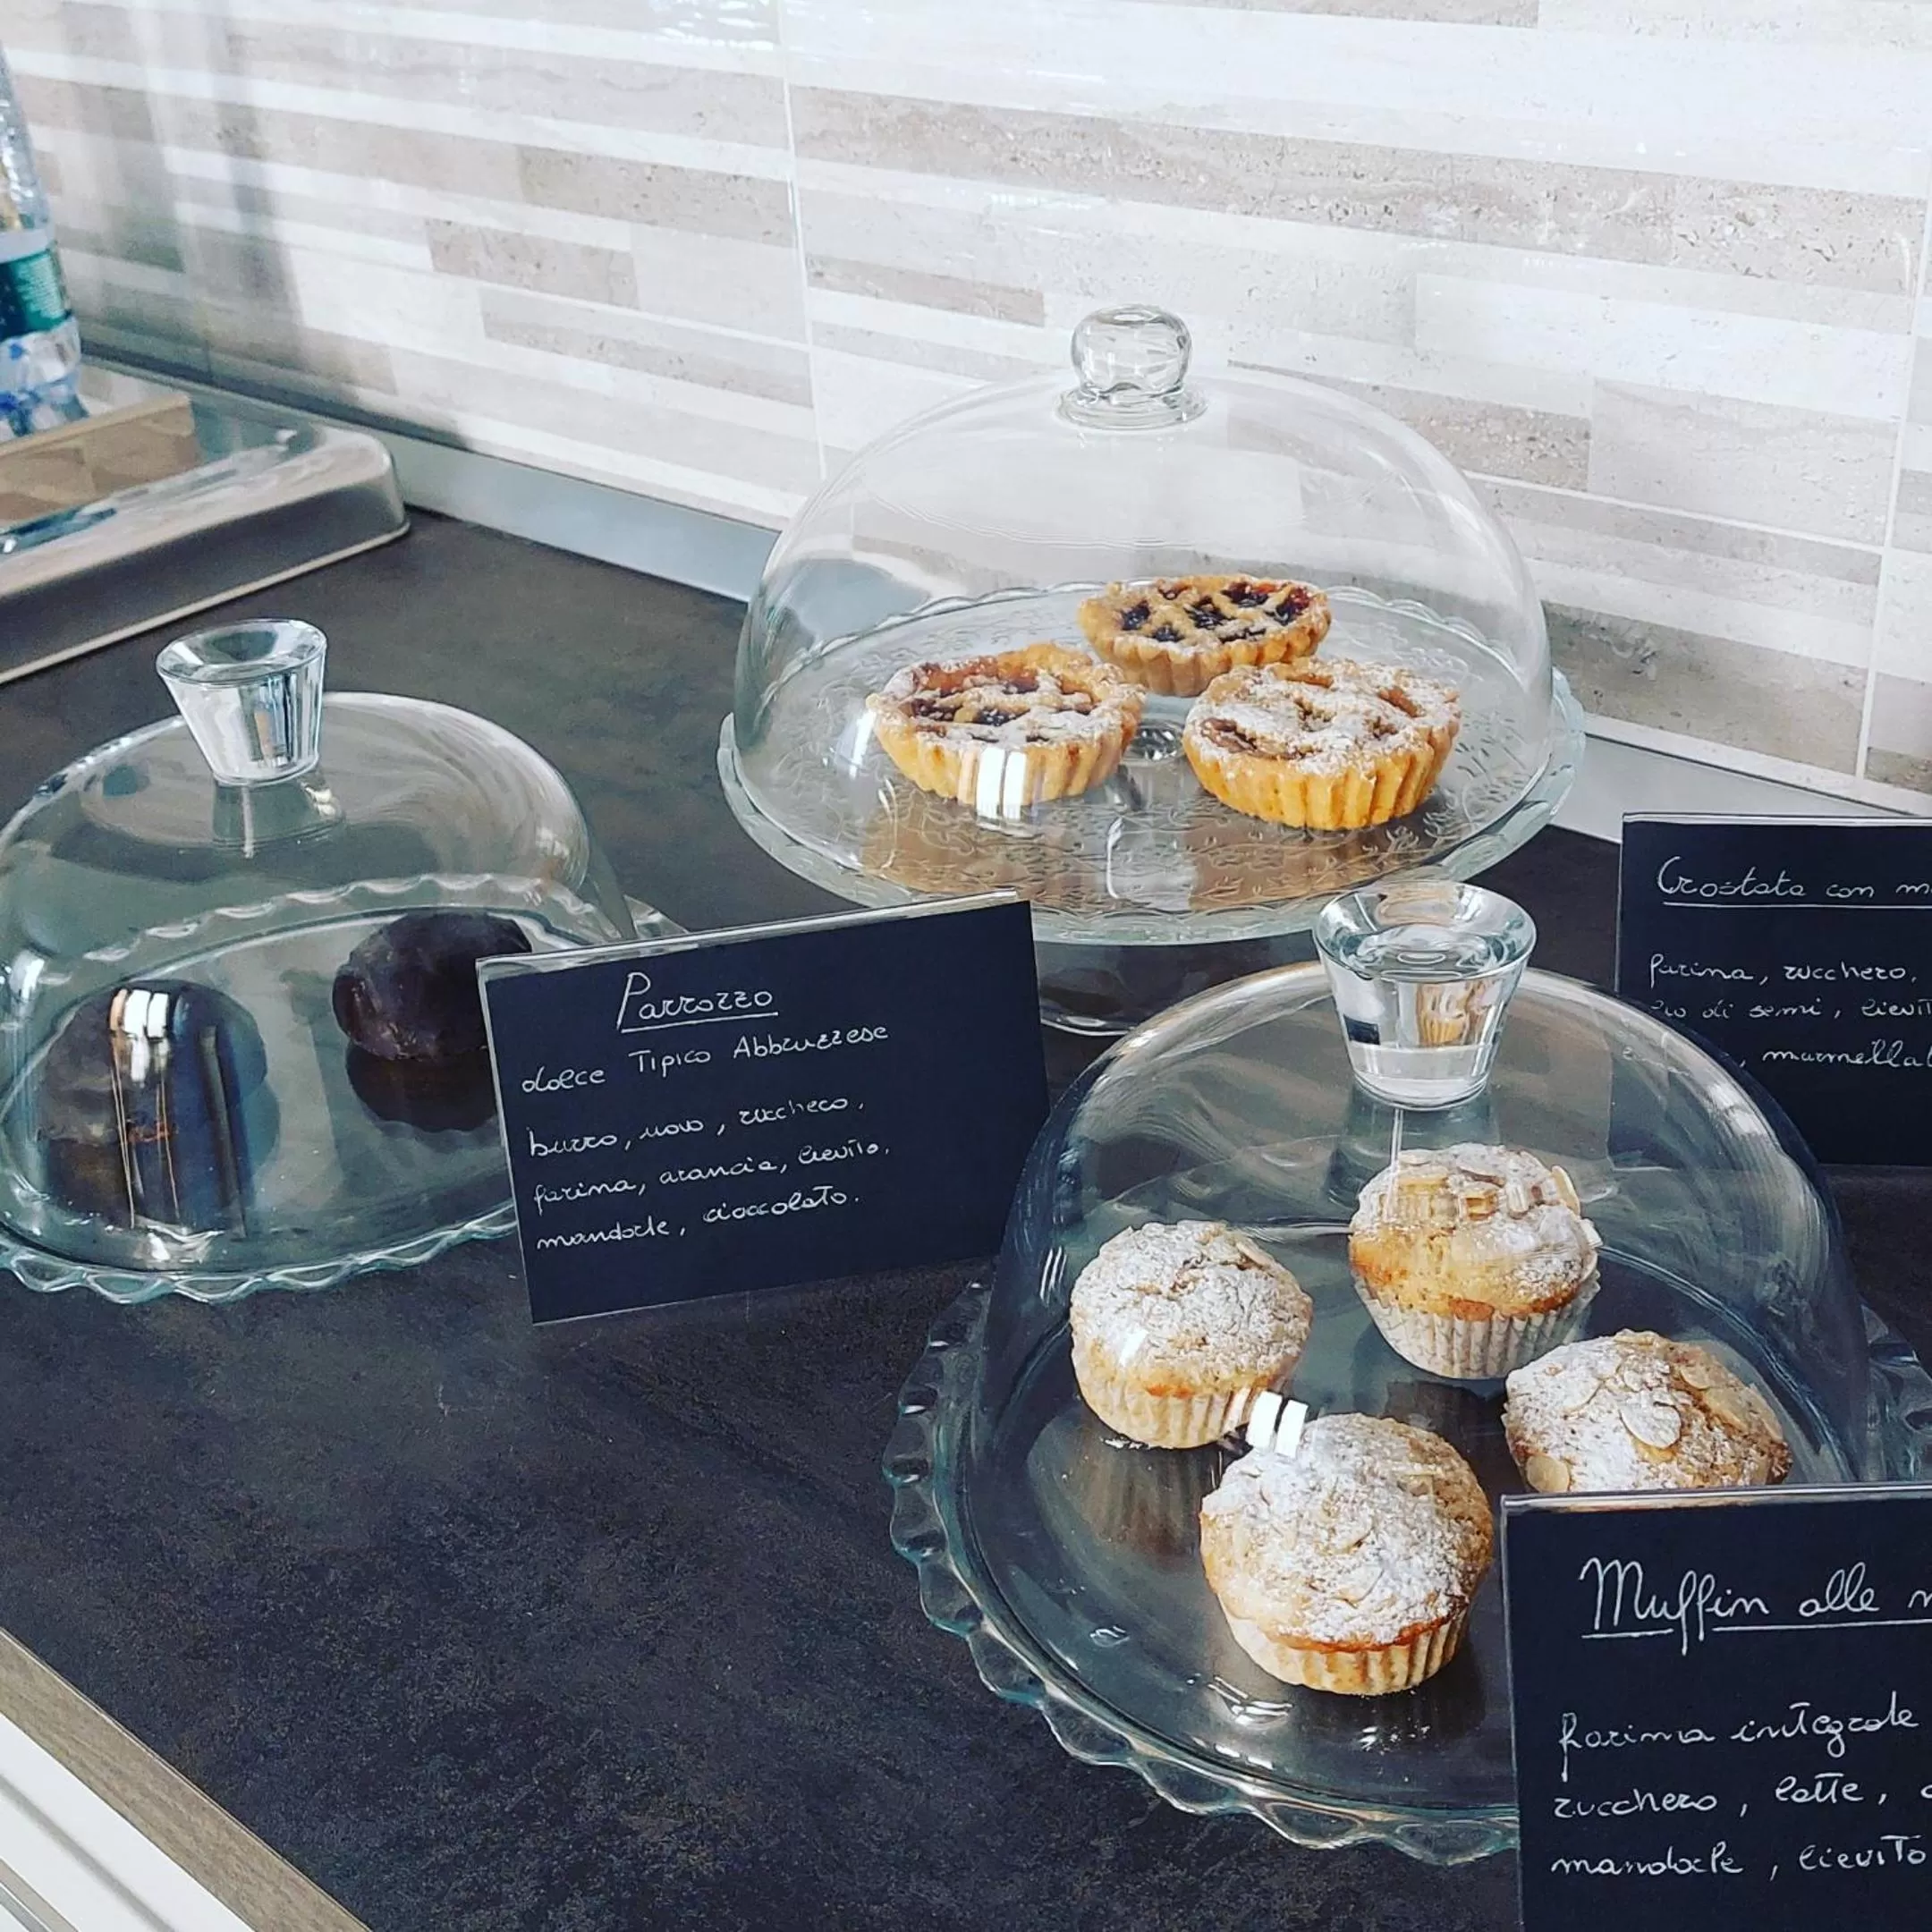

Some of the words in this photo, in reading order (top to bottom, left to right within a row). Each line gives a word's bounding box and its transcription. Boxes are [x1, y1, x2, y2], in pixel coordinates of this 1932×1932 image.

[1657, 856, 1806, 897] Crostata
[1826, 884, 1875, 899] con
[616, 971, 775, 1030] Parrozzo
[1702, 999, 1734, 1019] di
[521, 1065, 606, 1093] dolce
[628, 1049, 711, 1078] Tipico
[733, 1026, 888, 1059] Abbruzzese
[1579, 1556, 1769, 1657] Muffin
[1798, 1562, 1880, 1617] alle
[1558, 1712, 1716, 1783] farina
[1730, 1690, 1919, 1758] integrale
[1799, 1835, 1927, 1870] lievito
